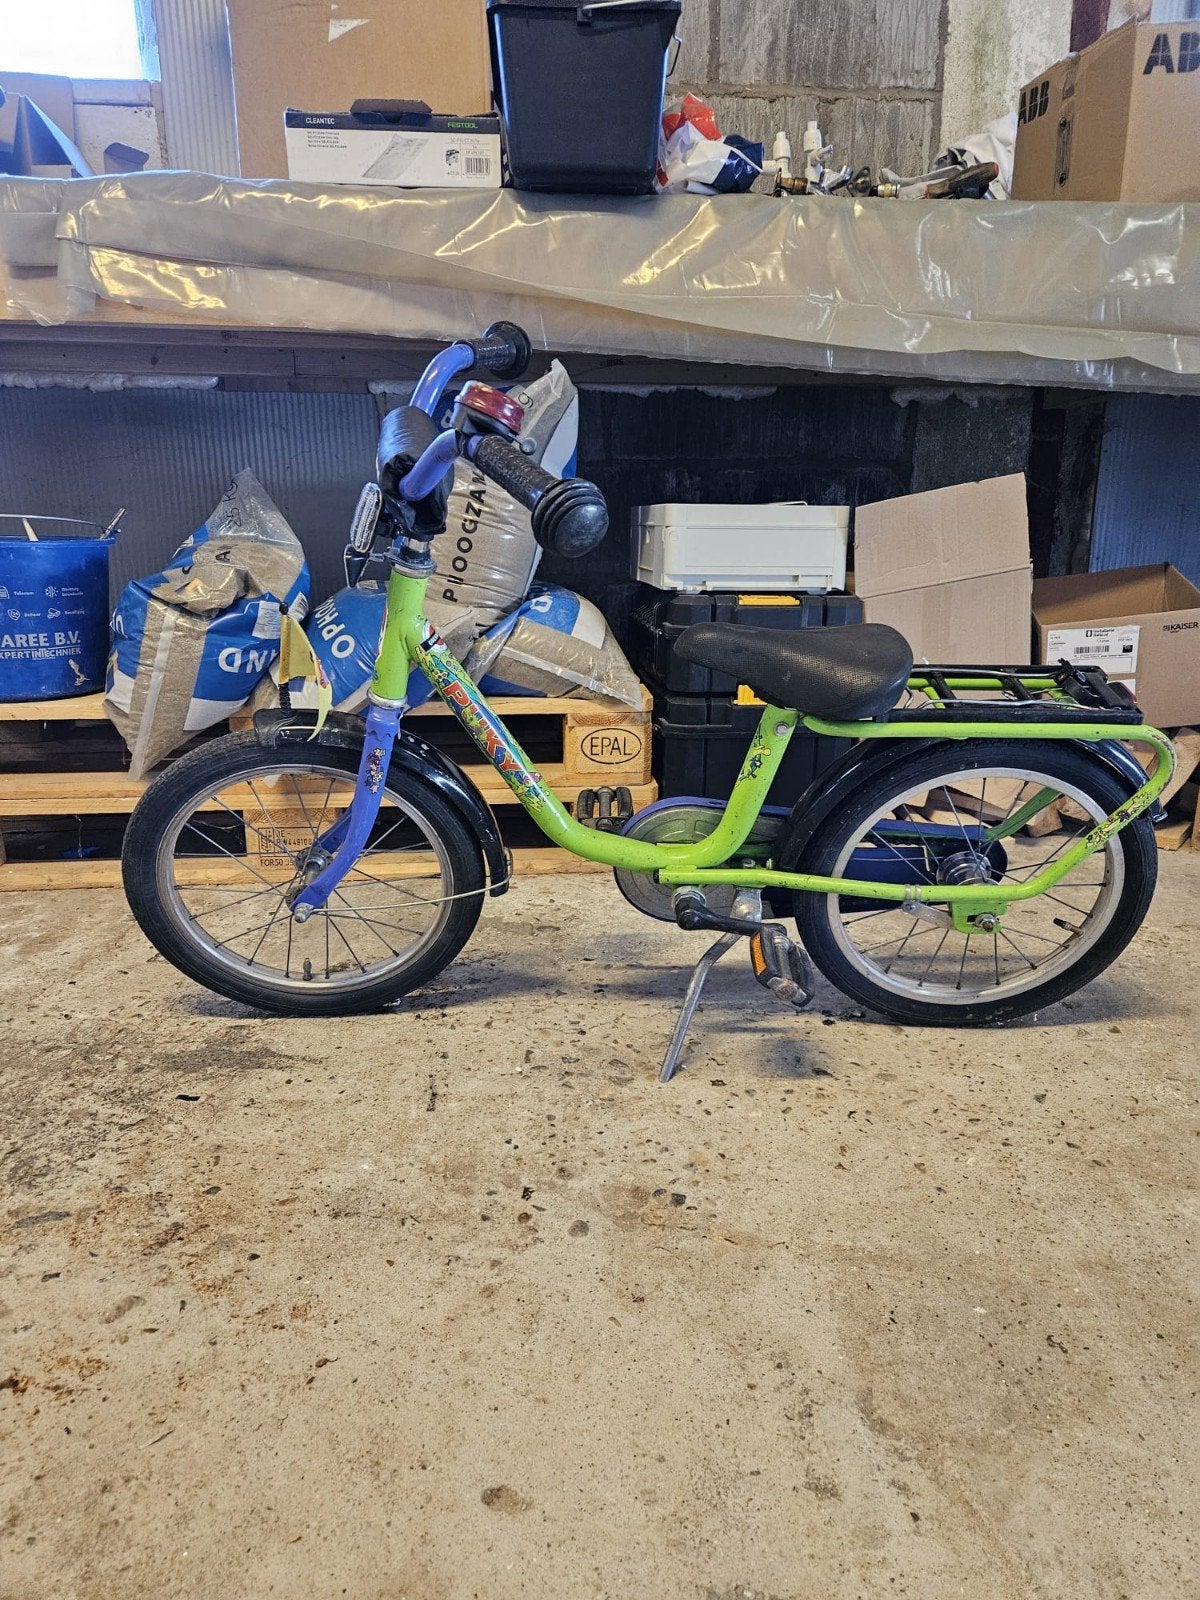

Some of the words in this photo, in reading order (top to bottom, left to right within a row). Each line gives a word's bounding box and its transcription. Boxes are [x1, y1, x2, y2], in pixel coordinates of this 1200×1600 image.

[1018, 80, 1050, 128] ABB
[305, 117, 336, 125] CLEANTEC
[447, 121, 479, 129] FESTOOL
[1170, 621, 1200, 630] KAISER
[1, 633, 50, 648] AREE
[54, 630, 81, 646] B.V.
[590, 736, 633, 756] EPAL
